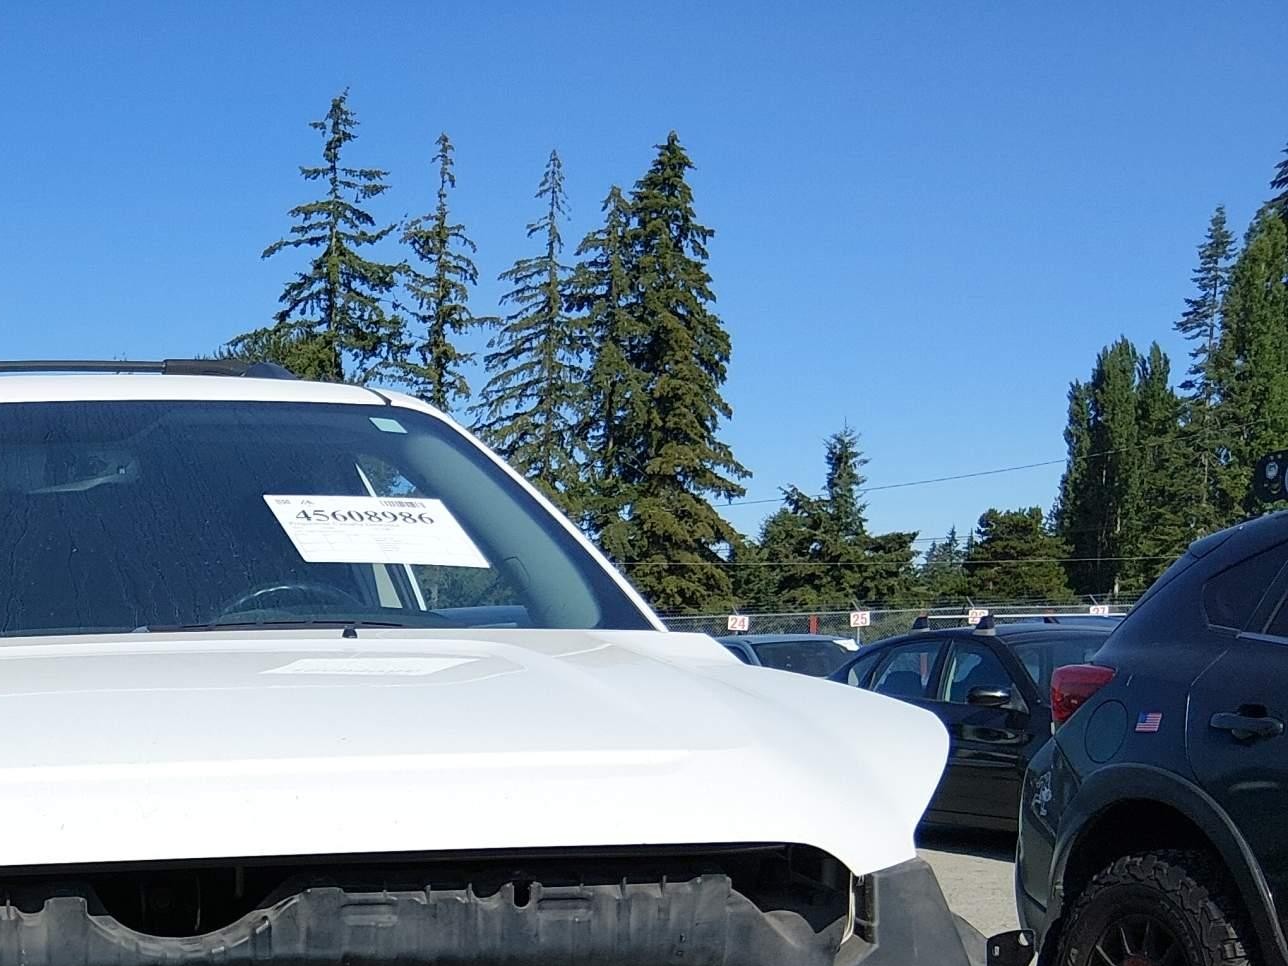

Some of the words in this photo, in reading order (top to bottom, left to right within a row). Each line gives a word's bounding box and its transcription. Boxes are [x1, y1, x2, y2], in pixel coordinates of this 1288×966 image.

[295, 509, 435, 525] 45608986
[729, 617, 747, 630] 24
[851, 613, 869, 626] 25
